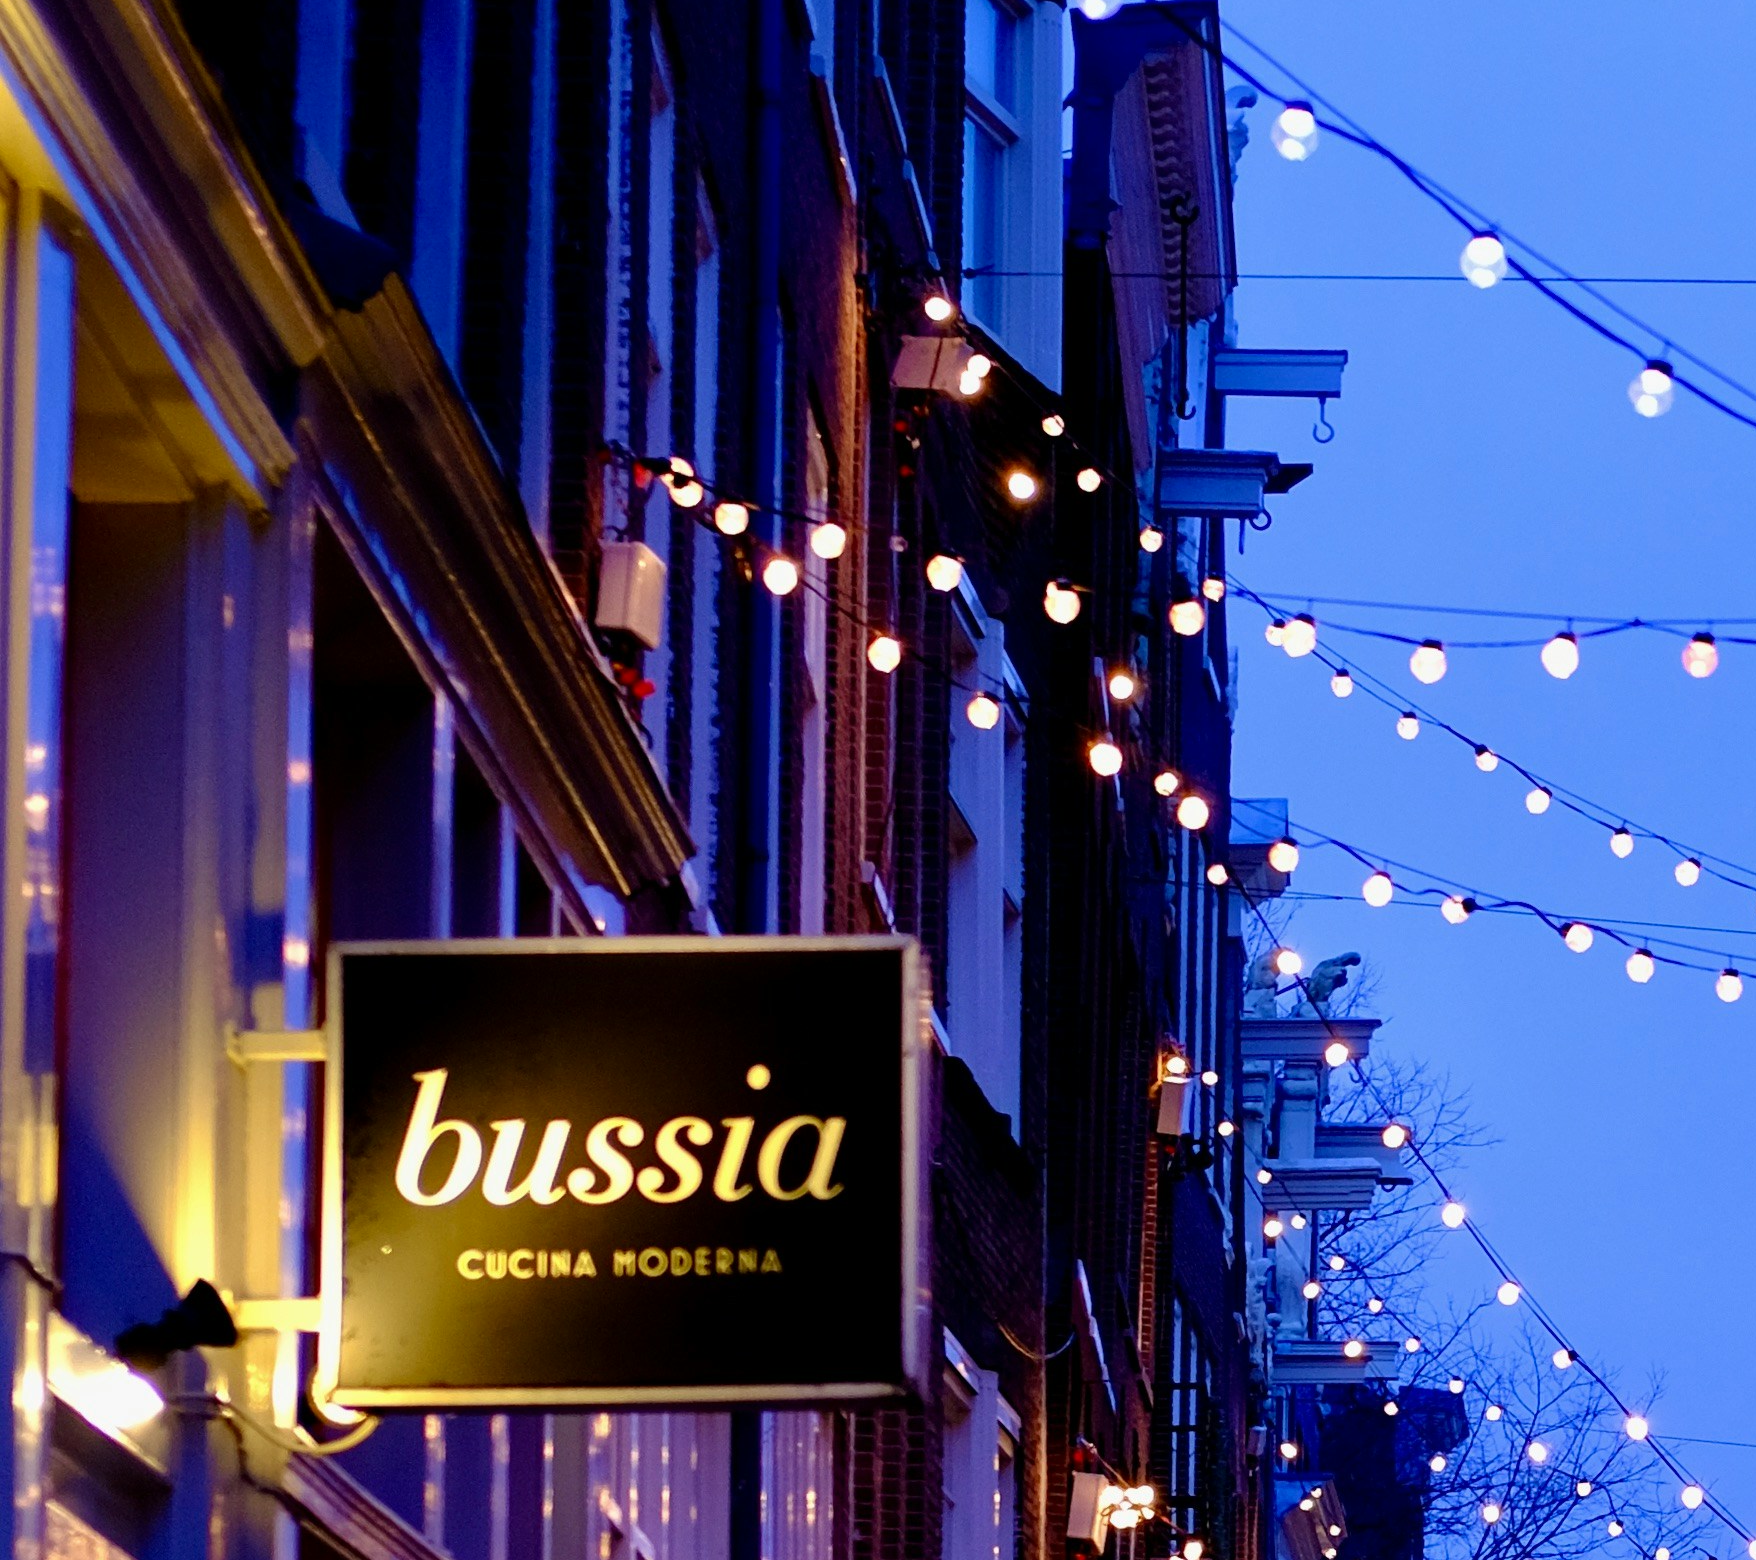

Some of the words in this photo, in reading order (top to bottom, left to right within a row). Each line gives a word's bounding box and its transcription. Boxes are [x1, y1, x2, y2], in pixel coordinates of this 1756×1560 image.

[394, 1063, 847, 1207] bussia
[456, 1248, 598, 1281] CUCINA
[612, 1245, 784, 1279] MODERNA
